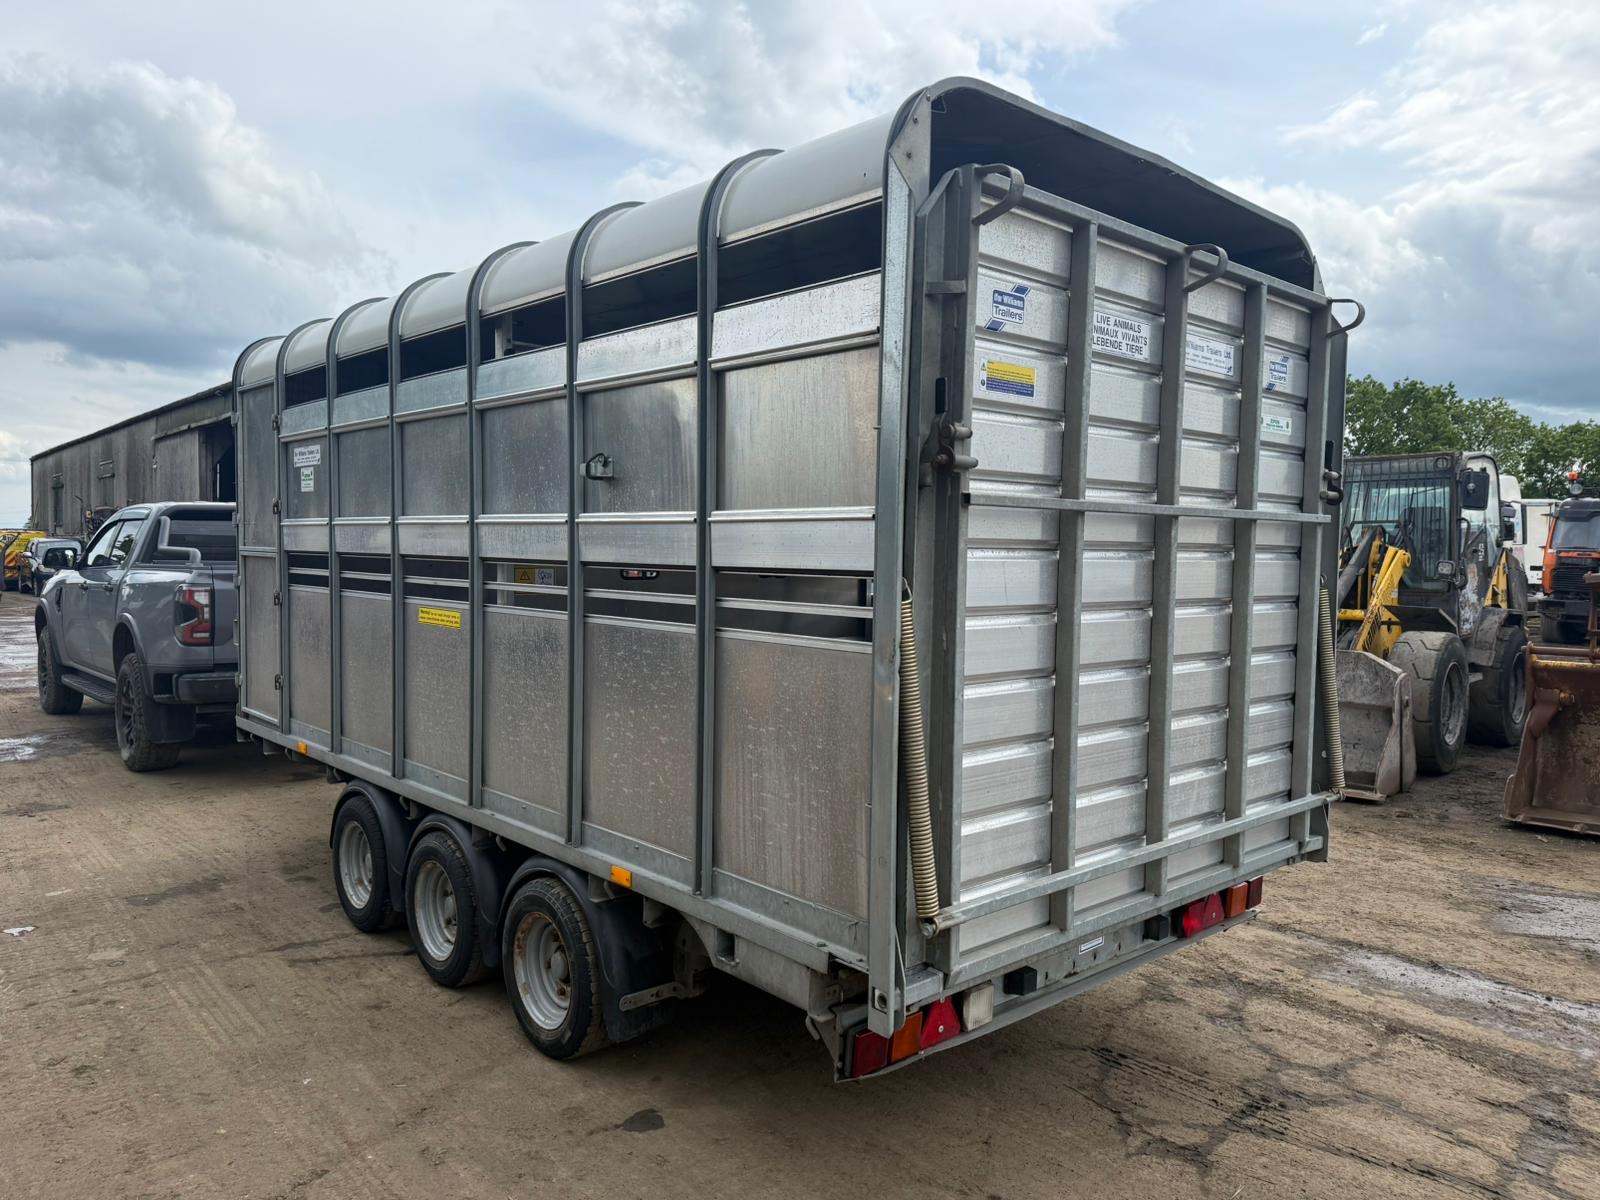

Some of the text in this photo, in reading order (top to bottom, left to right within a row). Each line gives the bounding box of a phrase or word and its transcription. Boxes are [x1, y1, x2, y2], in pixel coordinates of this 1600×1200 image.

[993, 305, 1023, 321] Trailers
[1096, 313, 1142, 334] LIVE ANIMALS
[1092, 335, 1123, 351] LEBENDE
[1125, 342, 1144, 356] TIERE
[1093, 324, 1148, 346] NIMAUX VIVANTS
